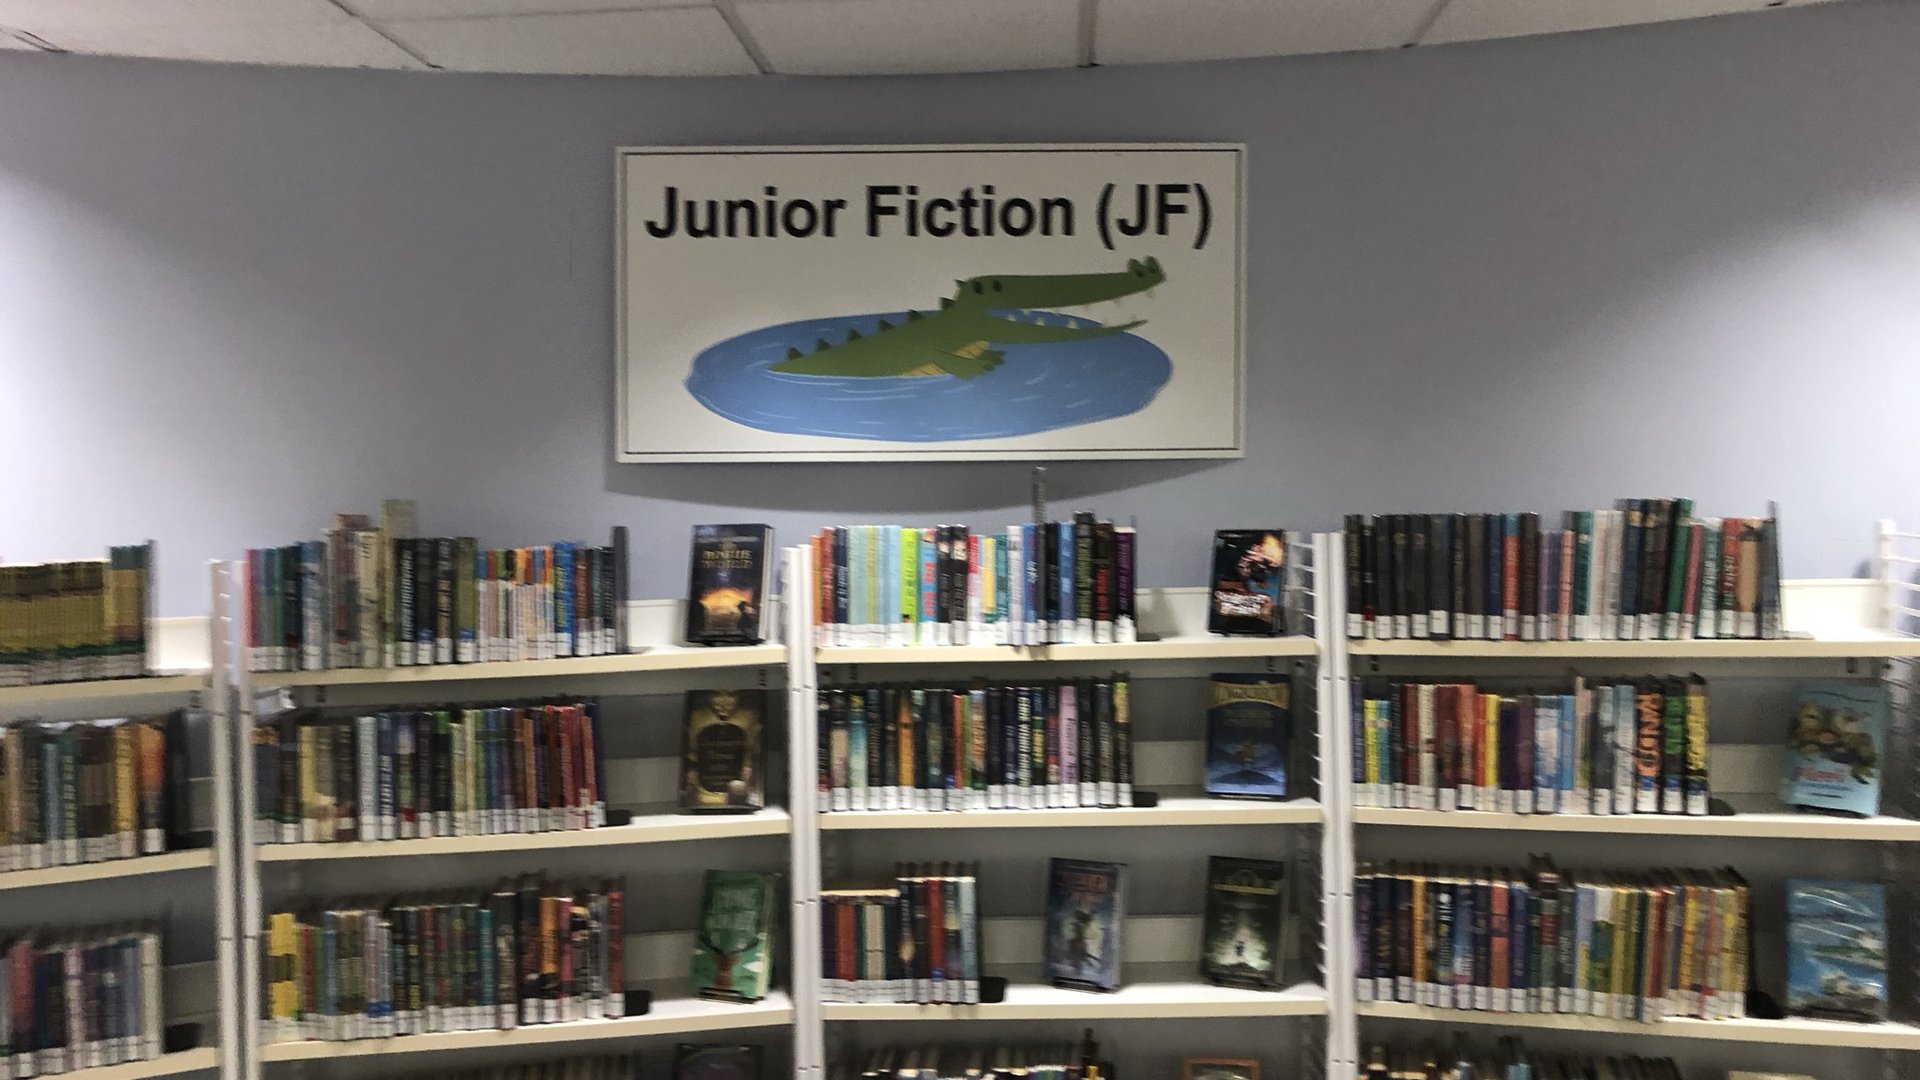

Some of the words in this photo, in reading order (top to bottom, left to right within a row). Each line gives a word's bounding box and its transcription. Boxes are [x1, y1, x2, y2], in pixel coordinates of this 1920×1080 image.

[643, 185, 848, 239] Junior
[865, 184, 1075, 238] Fiction
[1095, 182, 1213, 251] (JF)
